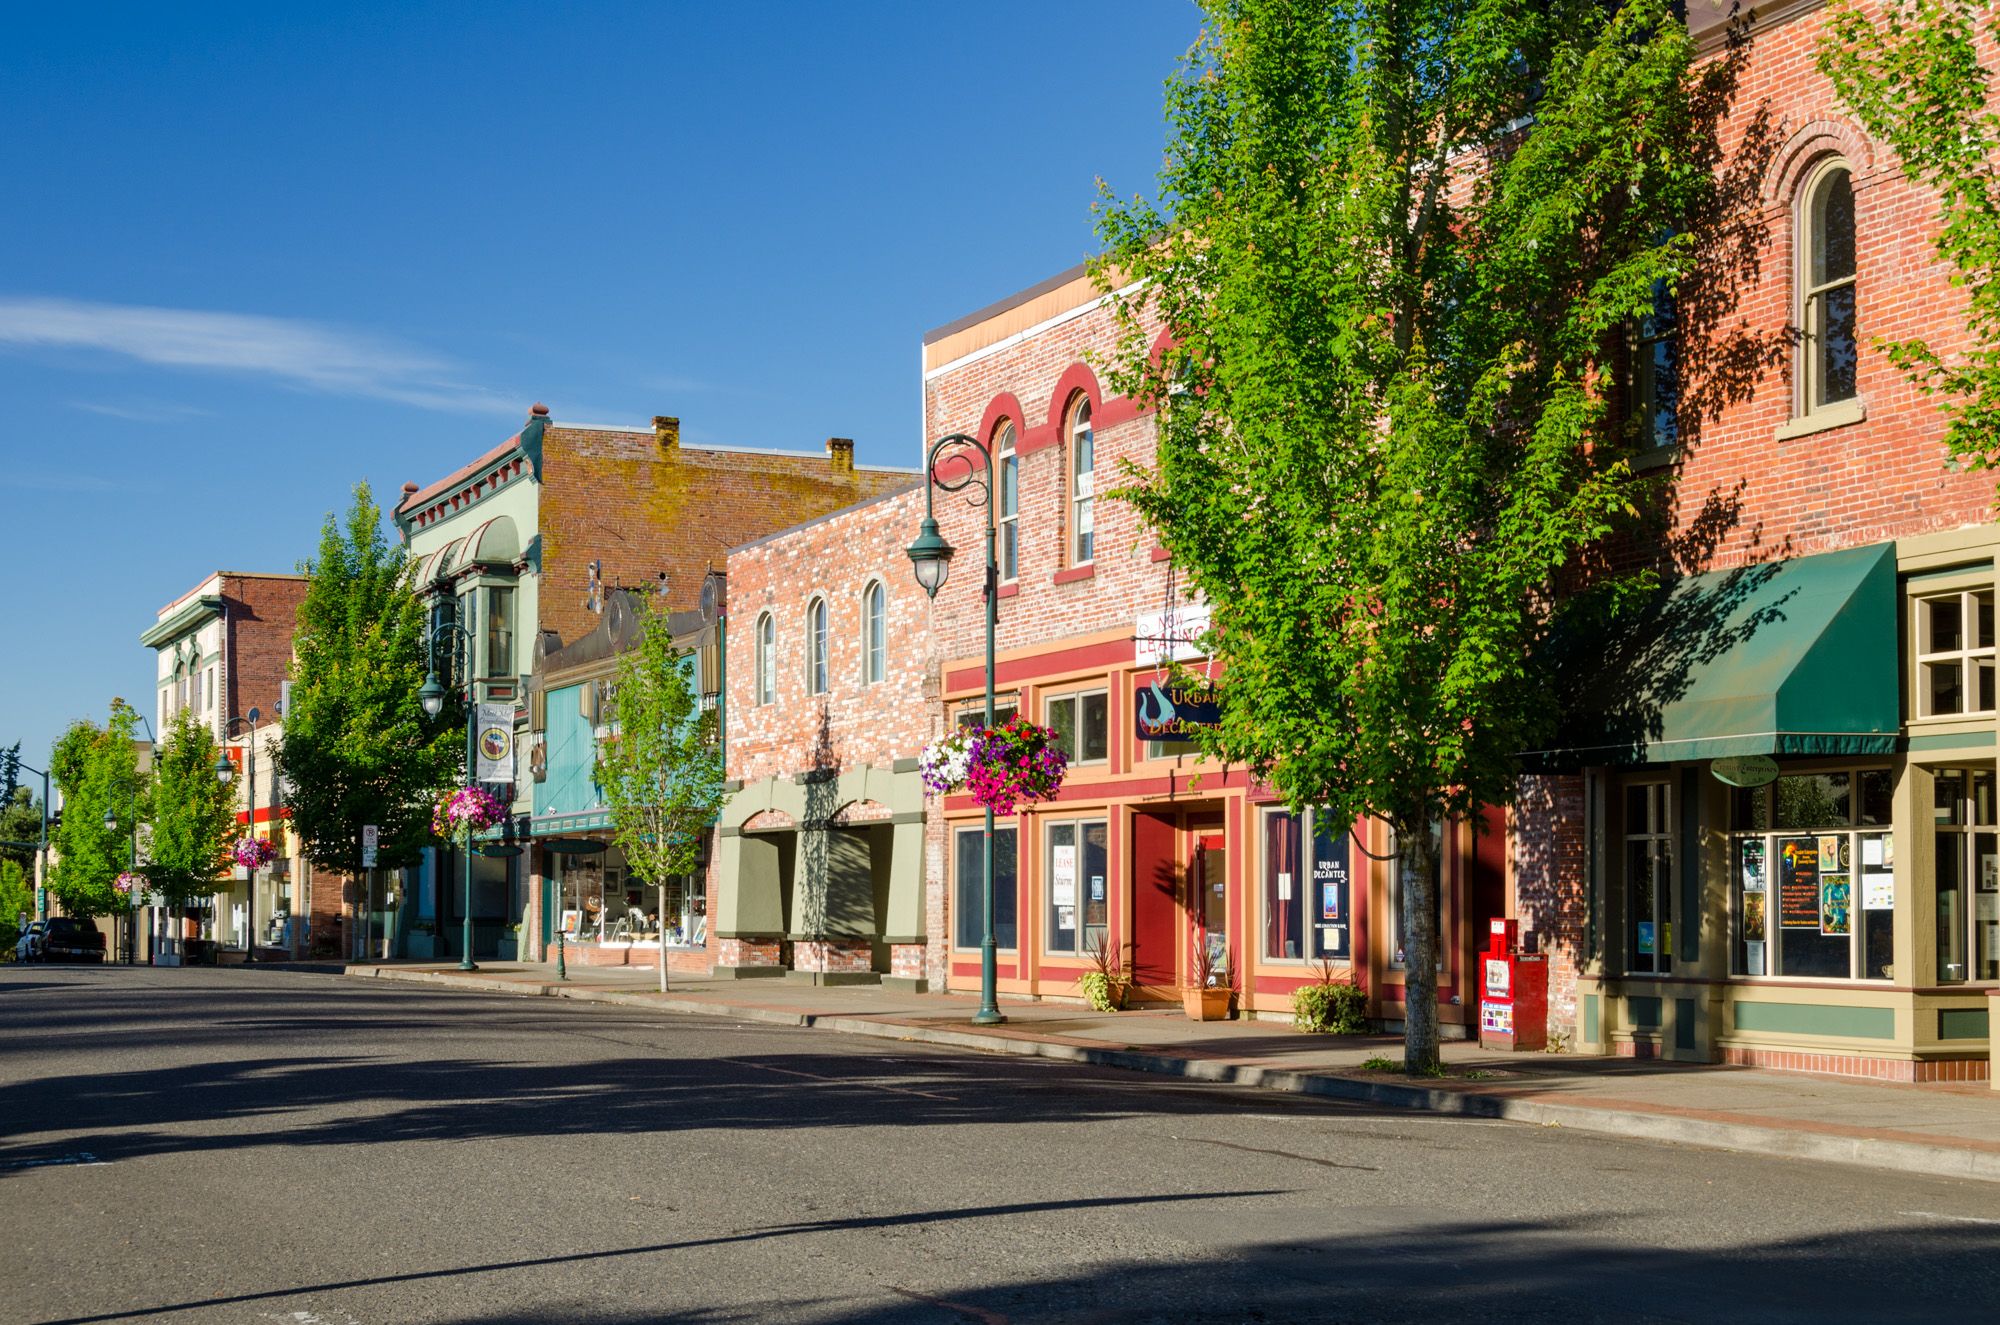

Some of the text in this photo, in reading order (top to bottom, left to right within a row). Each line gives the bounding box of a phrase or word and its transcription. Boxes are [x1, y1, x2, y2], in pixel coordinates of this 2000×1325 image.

[1158, 611, 1185, 630] NOW
[1055, 857, 1073, 868] LEASE
[1318, 861, 1340, 871] URBAN
[1313, 870, 1348, 881] DECANTER
